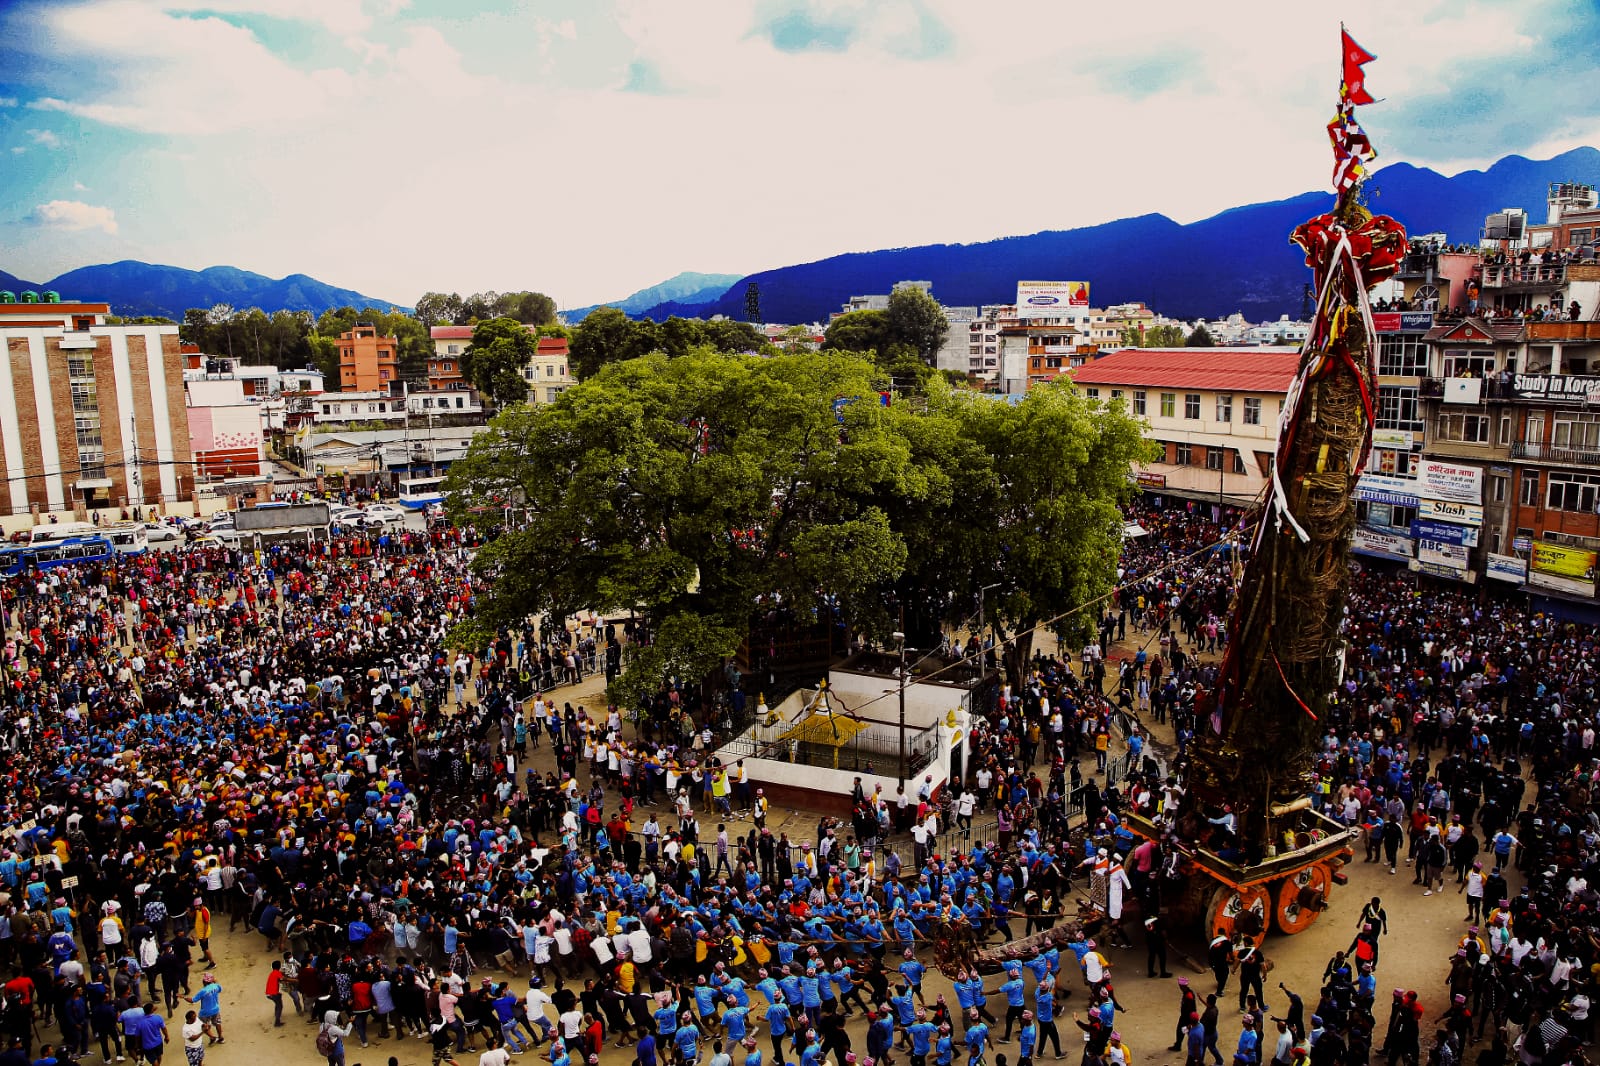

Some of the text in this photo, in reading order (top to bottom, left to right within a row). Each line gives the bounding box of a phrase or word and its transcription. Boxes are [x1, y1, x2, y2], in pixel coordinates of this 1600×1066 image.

[1402, 313, 1431, 326] Whirlpool
[1514, 374, 1600, 393] Study in Korea
[1433, 502, 1465, 516] Slash
[1420, 540, 1442, 552] ABC
